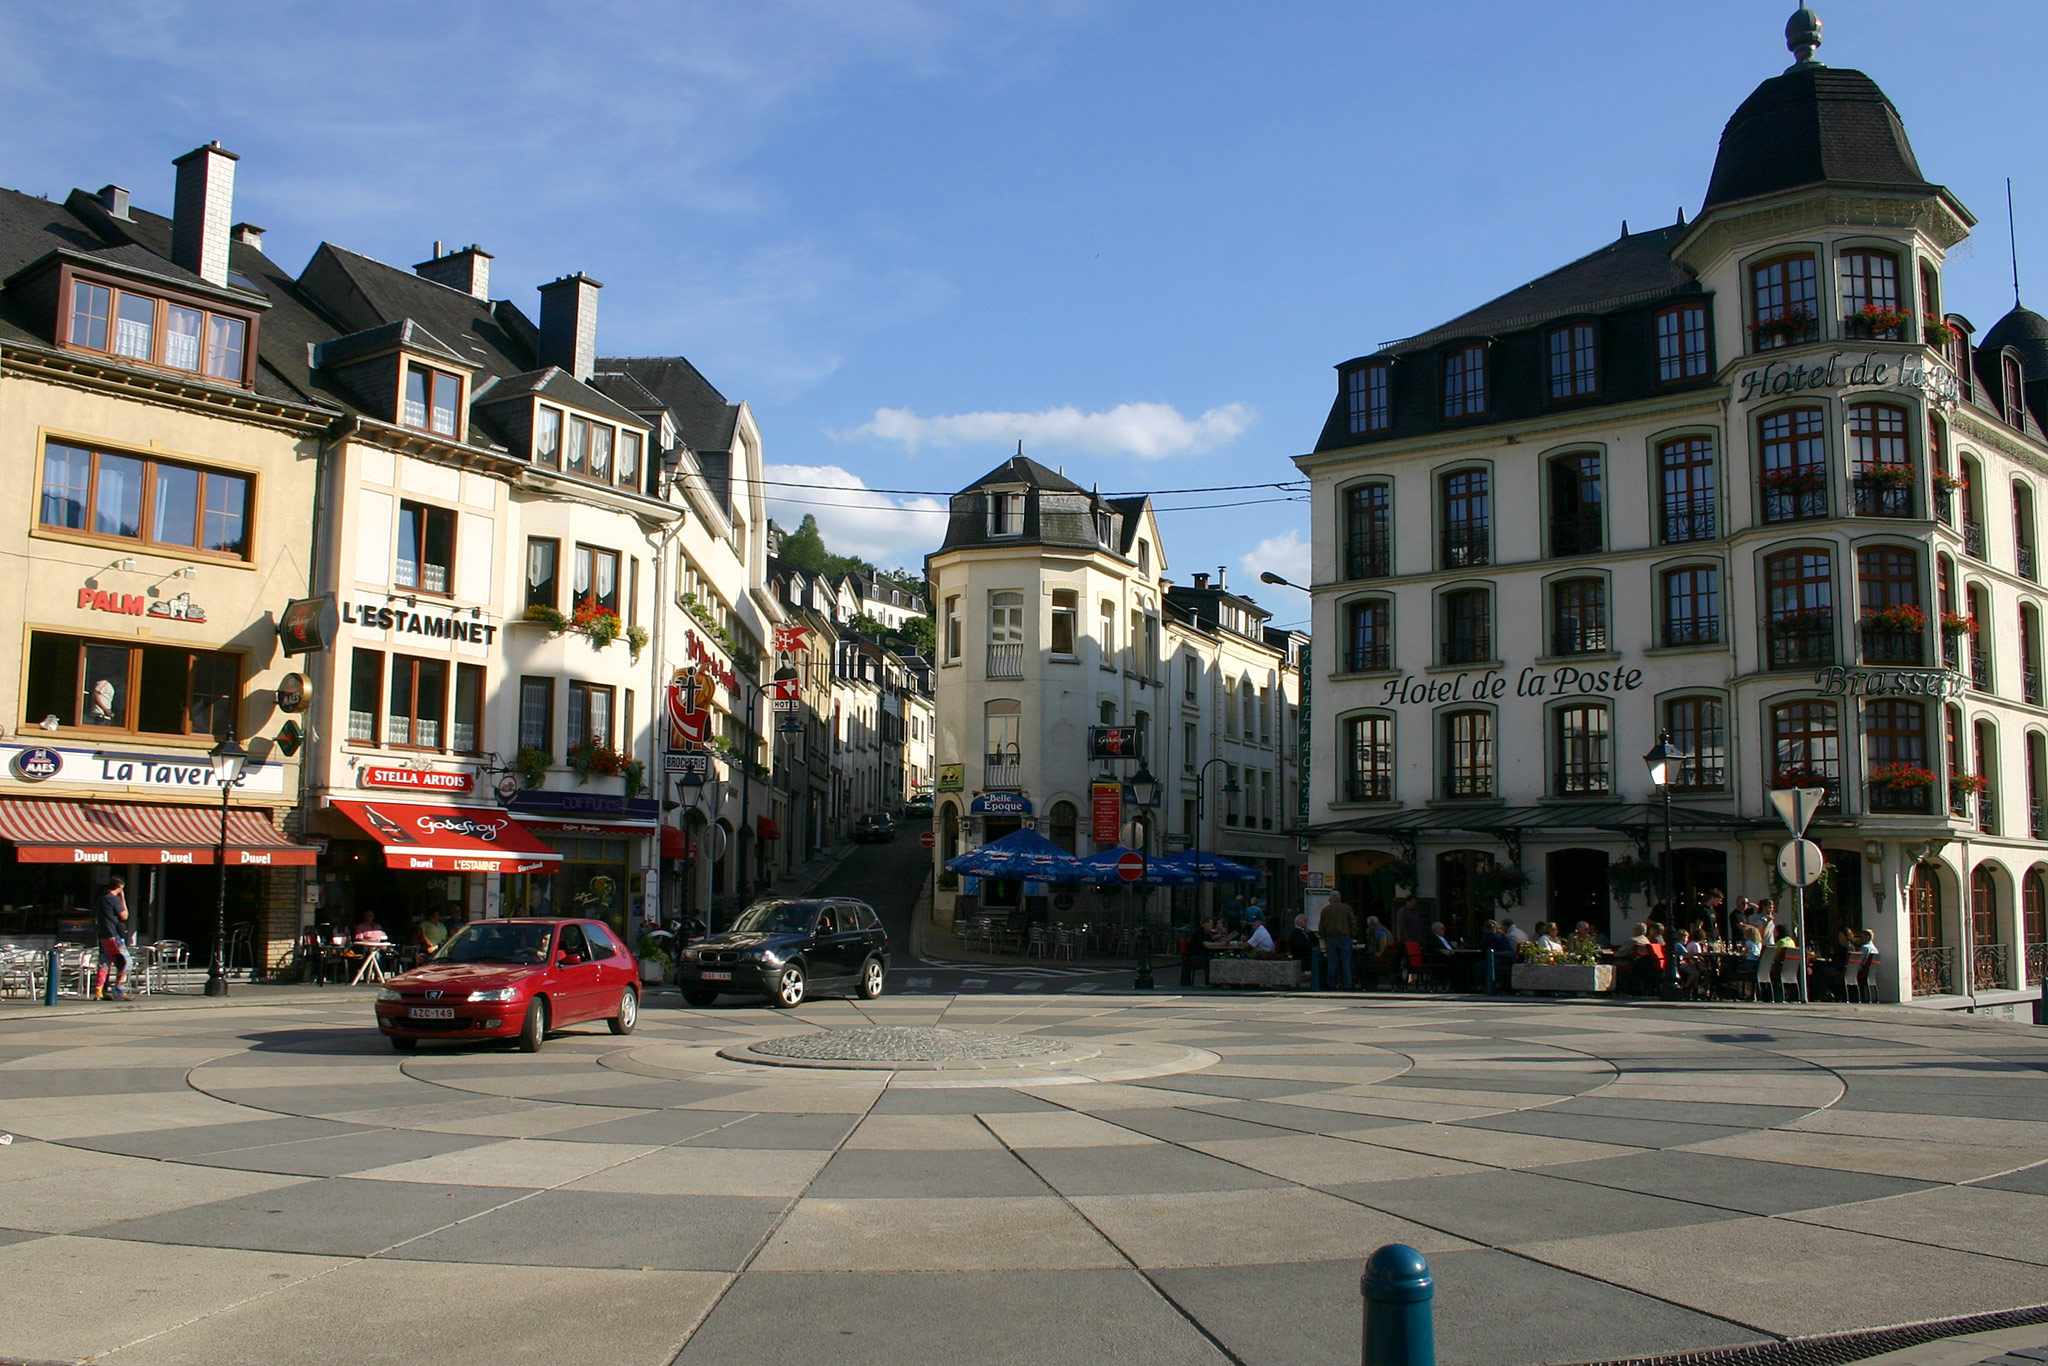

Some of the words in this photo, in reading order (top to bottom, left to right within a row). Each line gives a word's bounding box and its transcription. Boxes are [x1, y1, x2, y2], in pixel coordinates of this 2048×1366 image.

[1738, 352, 1842, 403] Hotel
[1850, 350, 1888, 386] de
[78, 588, 145, 616] PALM
[343, 601, 497, 645] L'ESTAMINET
[1380, 673, 1468, 706] Hotel
[1472, 670, 1506, 700] de
[1517, 667, 1546, 697] la
[1550, 665, 1643, 696] Poste
[26, 763, 55, 773] MAES
[666, 757, 705, 768] BROCHERIE
[102, 759, 133, 781] La
[374, 770, 418, 784] STELLA
[423, 773, 465, 787] ARTOIS
[990, 794, 1012, 802] Belle
[984, 801, 1022, 811] Epoque
[74, 849, 109, 863] Duvel
[161, 850, 193, 864] Duvel
[241, 851, 271, 865] Duvel
[410, 857, 434, 869] Duvel
[413, 1009, 453, 1018] AZC-149
